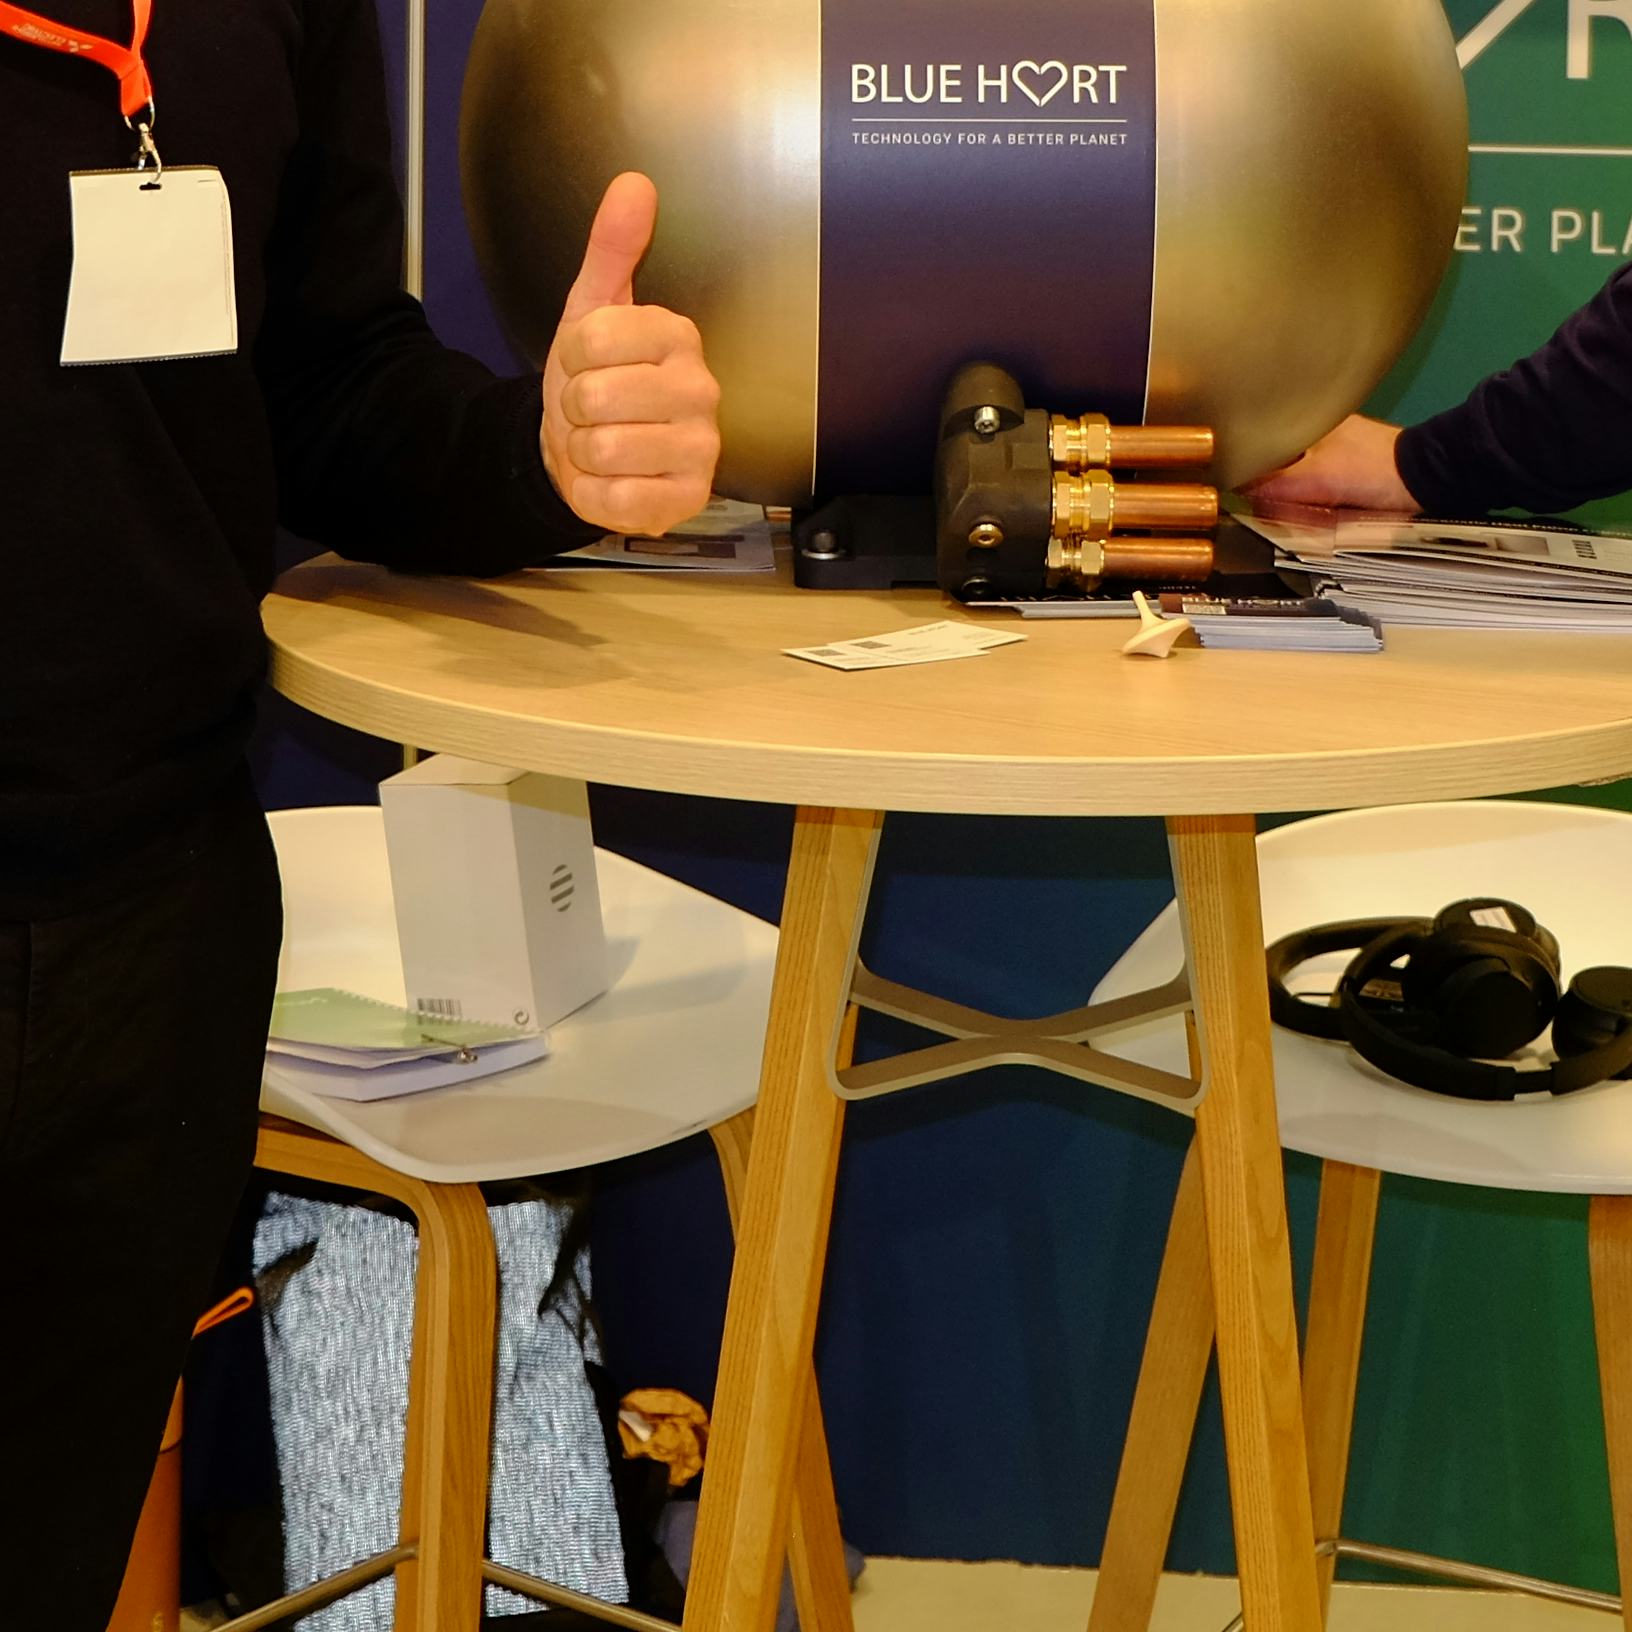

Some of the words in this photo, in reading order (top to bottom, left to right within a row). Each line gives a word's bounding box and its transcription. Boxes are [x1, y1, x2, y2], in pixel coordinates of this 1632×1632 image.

[850, 63, 964, 104] BLUE
[852, 132, 952, 146] TECHNOLOGY
[958, 133, 987, 146] FOR
[992, 133, 1002, 145] A
[1007, 133, 1065, 146] BETTER
[1070, 133, 1128, 146] PLANET
